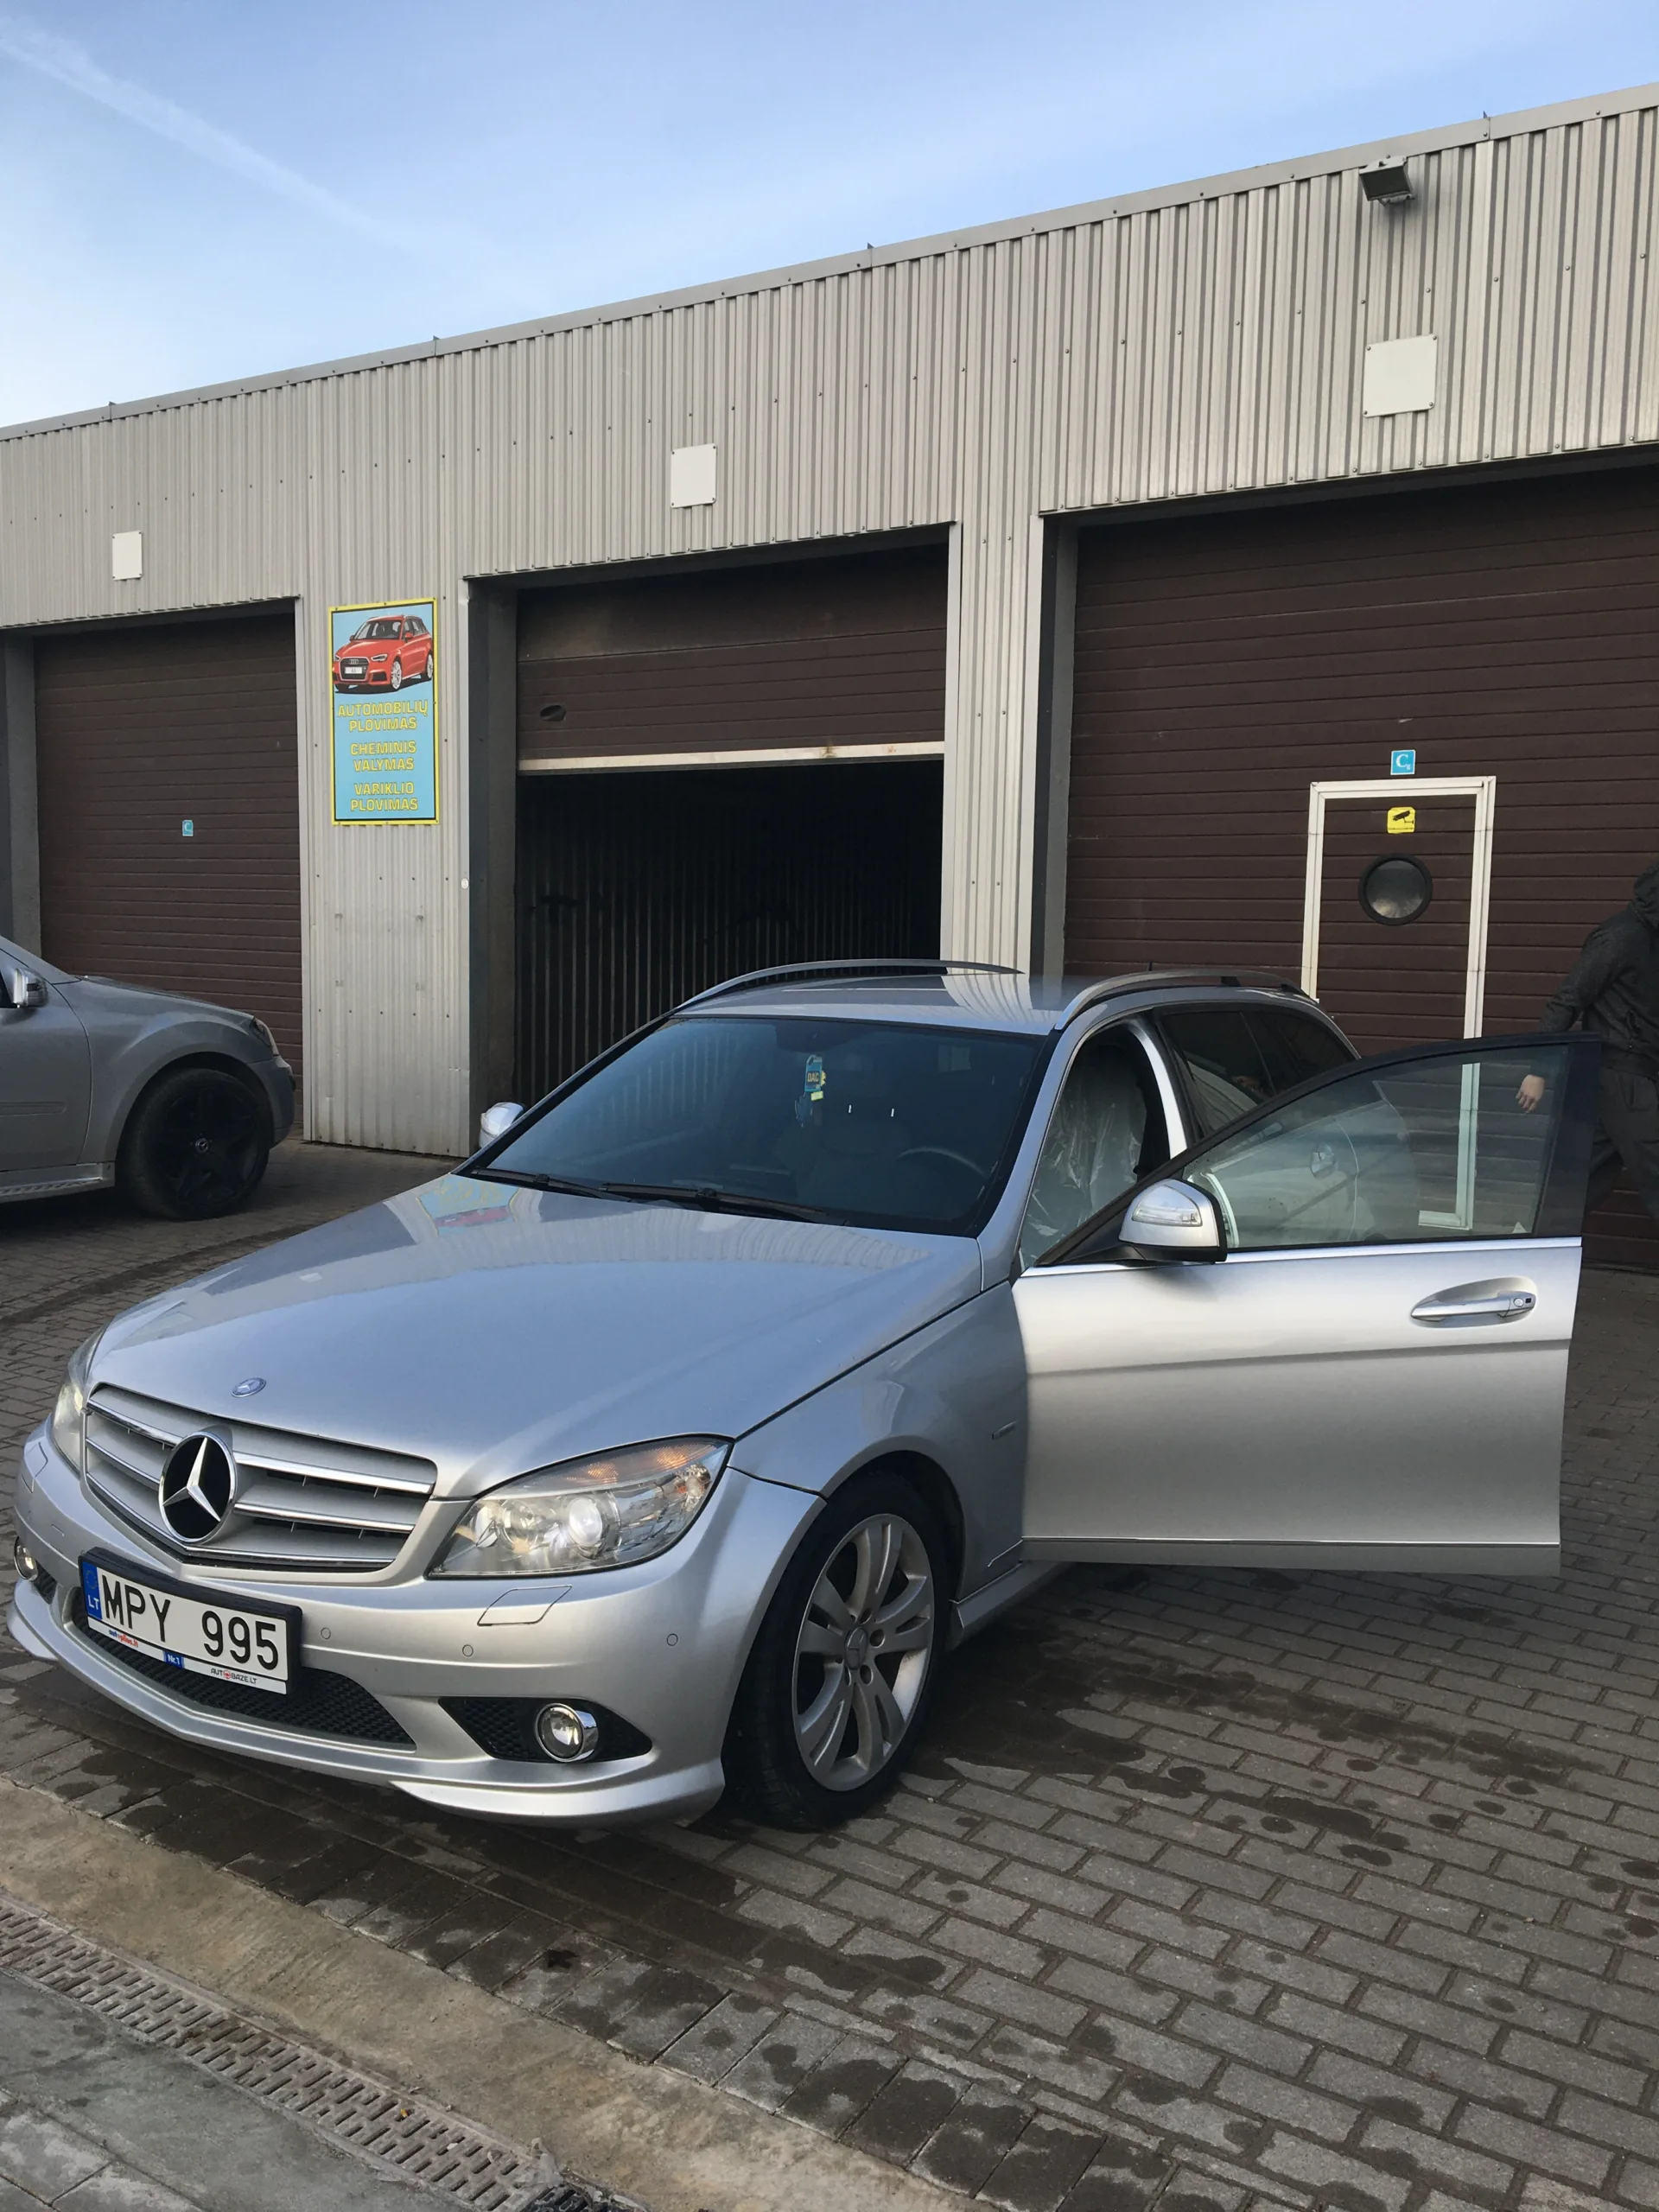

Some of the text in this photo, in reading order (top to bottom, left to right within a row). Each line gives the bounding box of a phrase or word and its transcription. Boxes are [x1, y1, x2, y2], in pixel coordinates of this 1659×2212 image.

[338, 700, 429, 716] AUTOMOBILIŲ
[349, 716, 417, 732] PLOVIMAS
[350, 741, 417, 755] CHEMINIS
[353, 757, 415, 772] VALYMAS
[354, 781, 415, 796] VARIKLIO
[350, 798, 419, 811] PLOVIMAS
[87, 1594, 99, 1611] LT
[101, 1574, 279, 1670] MPY 995
